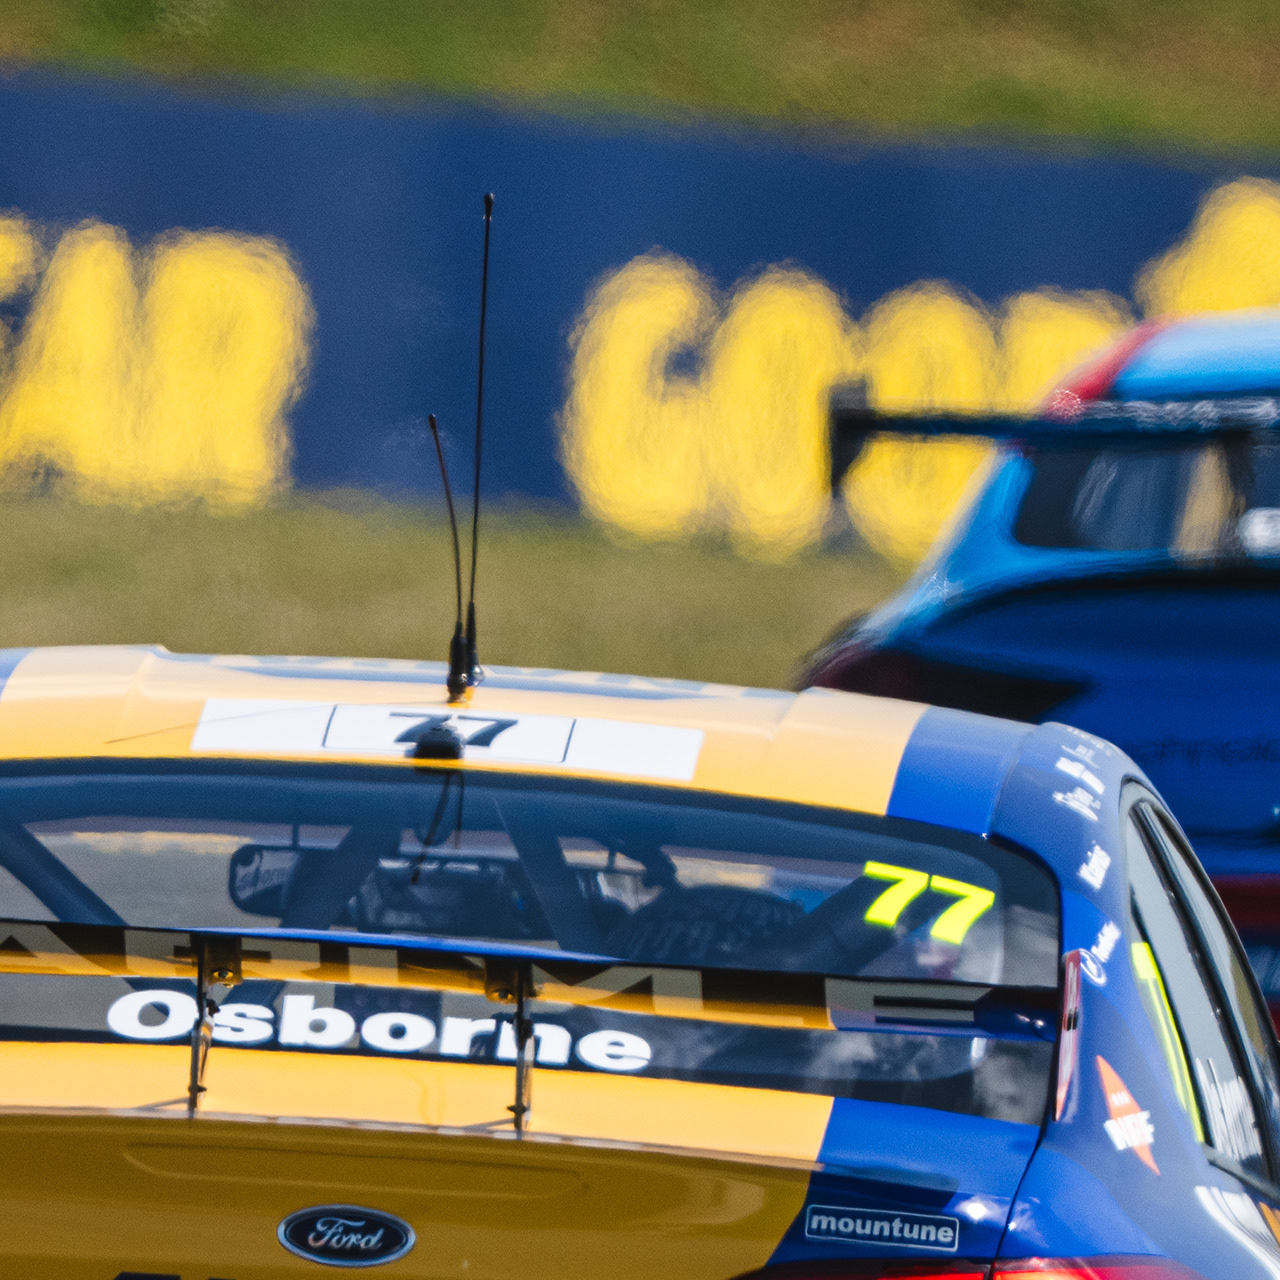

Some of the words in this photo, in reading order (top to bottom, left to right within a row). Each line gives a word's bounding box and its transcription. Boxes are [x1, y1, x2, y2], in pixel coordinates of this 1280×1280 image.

[389, 712, 519, 748] 77
[864, 860, 995, 945] 77
[106, 988, 652, 1072] Osborne
[308, 1216, 385, 1249] Ford
[810, 1213, 955, 1244] mountune
